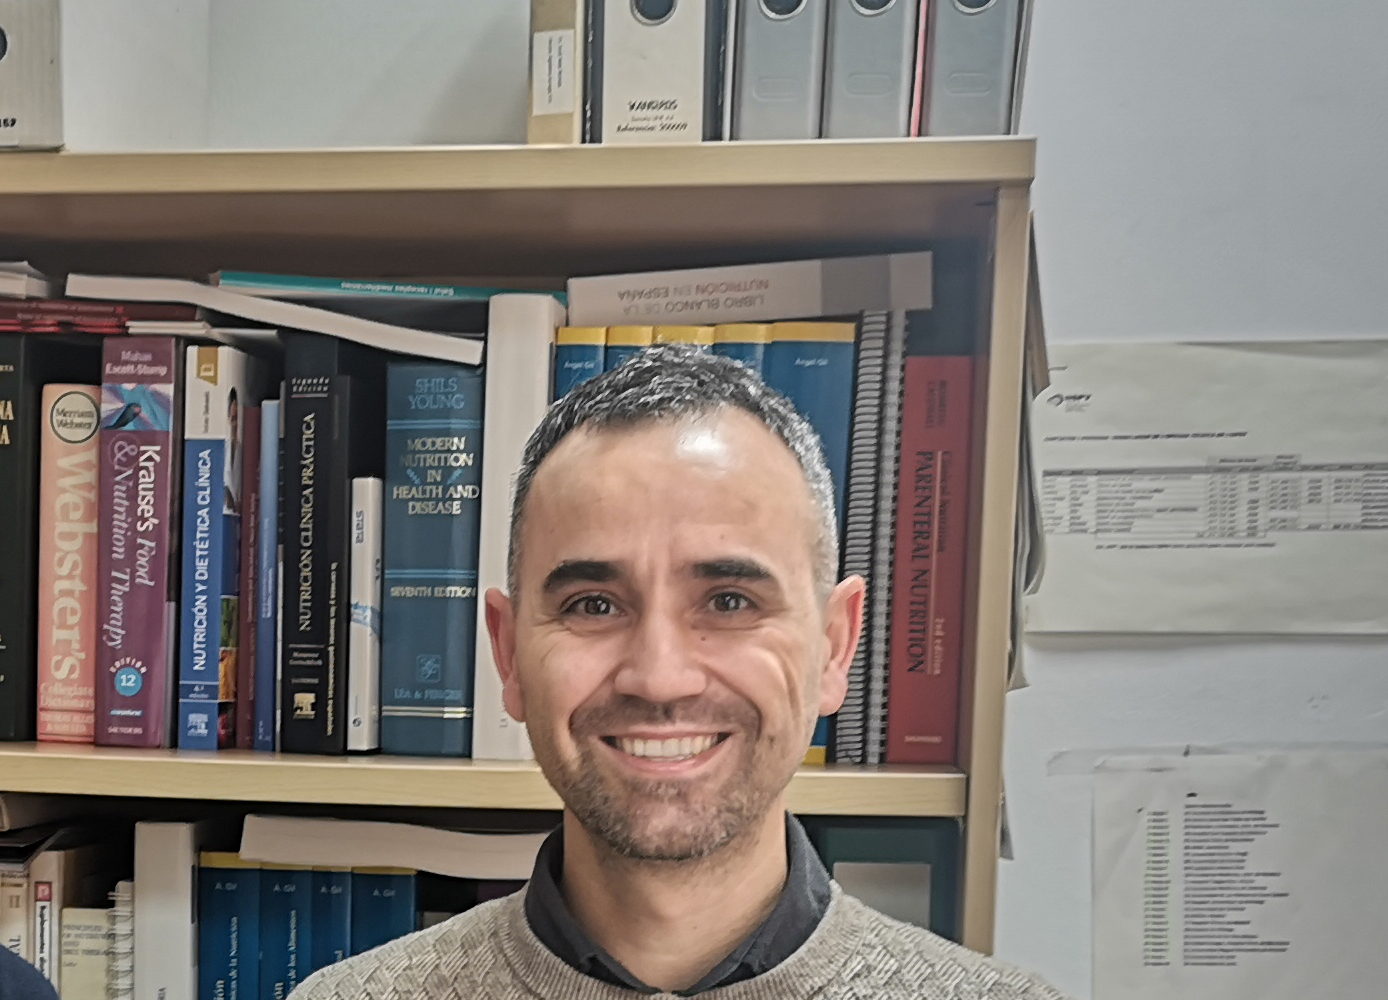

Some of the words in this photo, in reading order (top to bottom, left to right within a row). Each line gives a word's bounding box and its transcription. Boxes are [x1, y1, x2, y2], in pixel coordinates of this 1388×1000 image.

[617, 285, 670, 303] ESPAÑA
[673, 285, 692, 297] EN
[693, 276, 769, 297] NUTRICIÓN
[622, 304, 639, 316] LA
[644, 303, 661, 315] DE
[664, 296, 720, 313] BLANCO
[723, 293, 764, 309] LIBRO
[416, 377, 457, 393] SHILS
[408, 393, 465, 410] YOUNG
[300, 412, 316, 485] PRÁCTICA
[407, 436, 466, 451] MODERN
[113, 440, 138, 469] &
[399, 453, 474, 467] NUTRITION
[197, 448, 212, 505] CLÍNICA
[427, 469, 442, 483] IN
[136, 445, 161, 532] Krause's
[393, 485, 443, 499] HEALTH
[445, 485, 480, 499] AND
[111, 466, 135, 560] Nutrition
[408, 501, 462, 515] DISEASE
[910, 450, 934, 561] PARENTERAL
[299, 487, 314, 546] CLÍNICA
[194, 507, 210, 579] DIETÉTICA
[50, 453, 98, 680] Webster's
[136, 537, 157, 587] Food
[196, 580, 209, 592] Y
[298, 547, 314, 632] NUTRICIÓN
[390, 586, 432, 598] SEVENTH
[434, 586, 476, 598] EDITION
[103, 566, 133, 651] Therapy
[905, 568, 928, 673] NUTRITION
[933, 616, 945, 636] 2nd
[192, 596, 207, 671] NUTRICIÓN
[109, 656, 148, 674] EDITION
[932, 638, 944, 675] edition
[120, 675, 136, 687] 12
[285, 909, 300, 951] Alimentos
